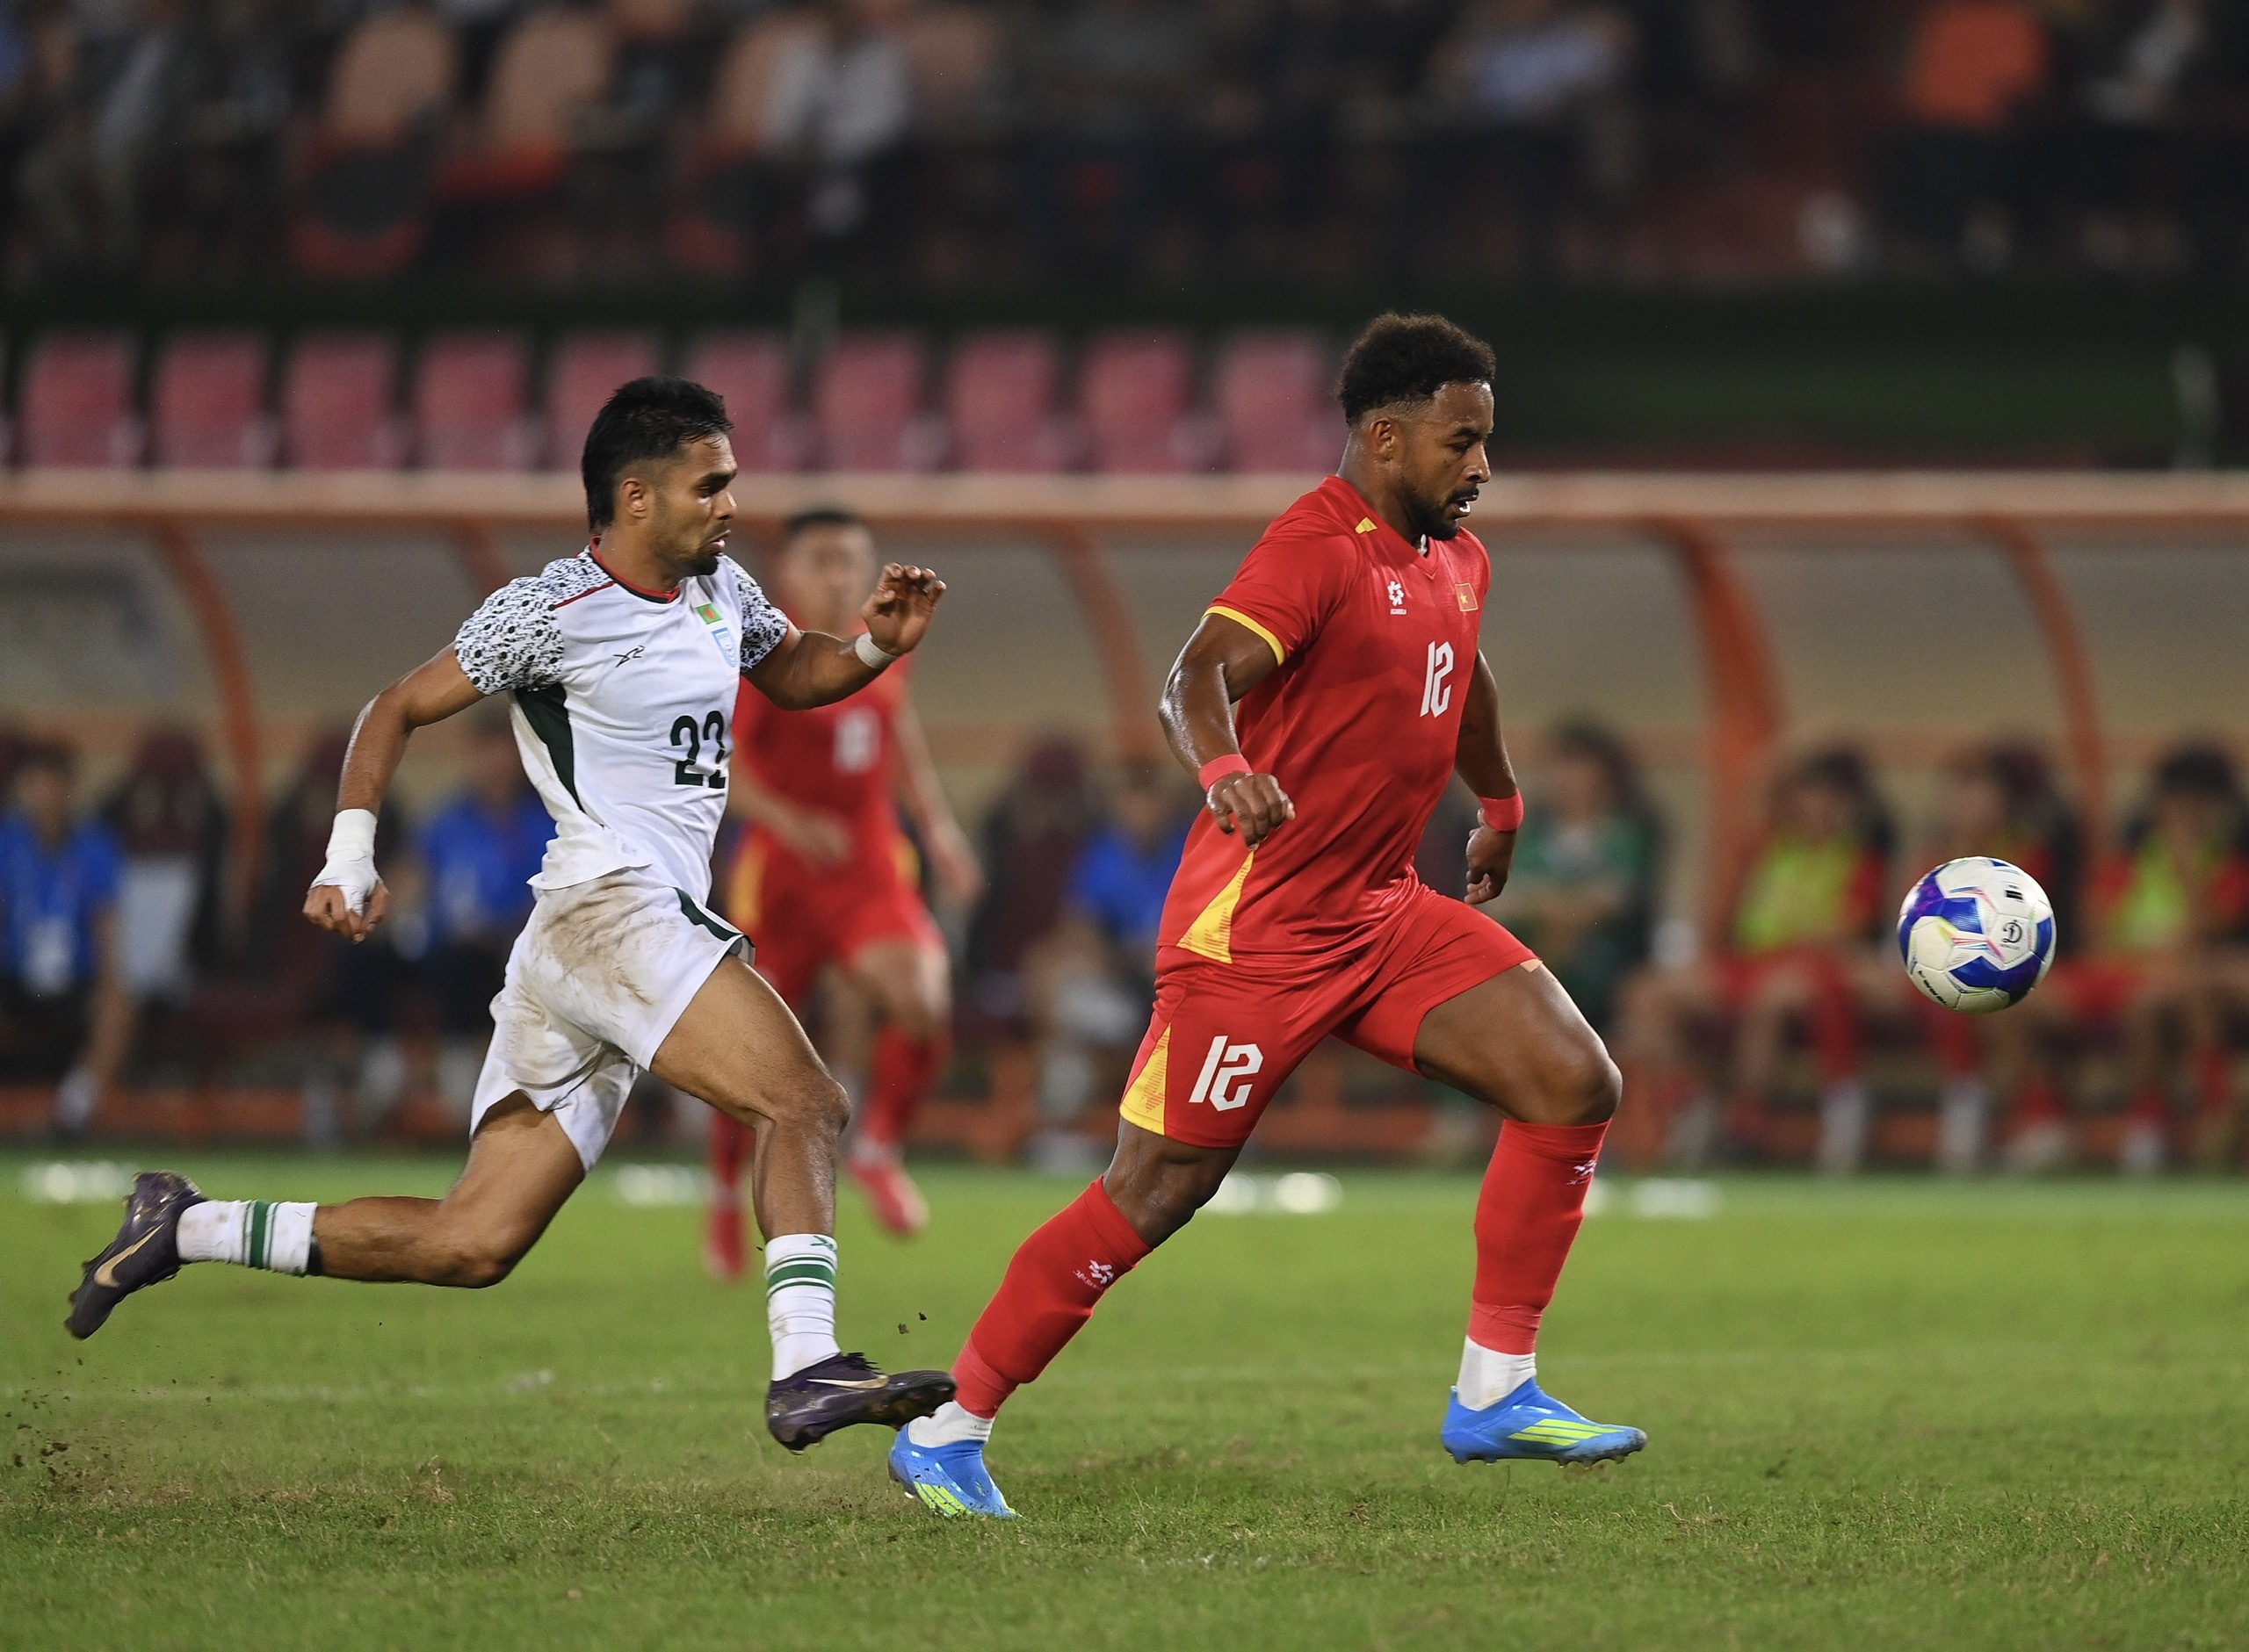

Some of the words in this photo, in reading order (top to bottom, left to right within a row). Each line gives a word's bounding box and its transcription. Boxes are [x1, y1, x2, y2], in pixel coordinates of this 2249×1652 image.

[1420, 640, 1455, 718] 12
[669, 710, 726, 789] 22
[1188, 1035, 1264, 1112] 12
